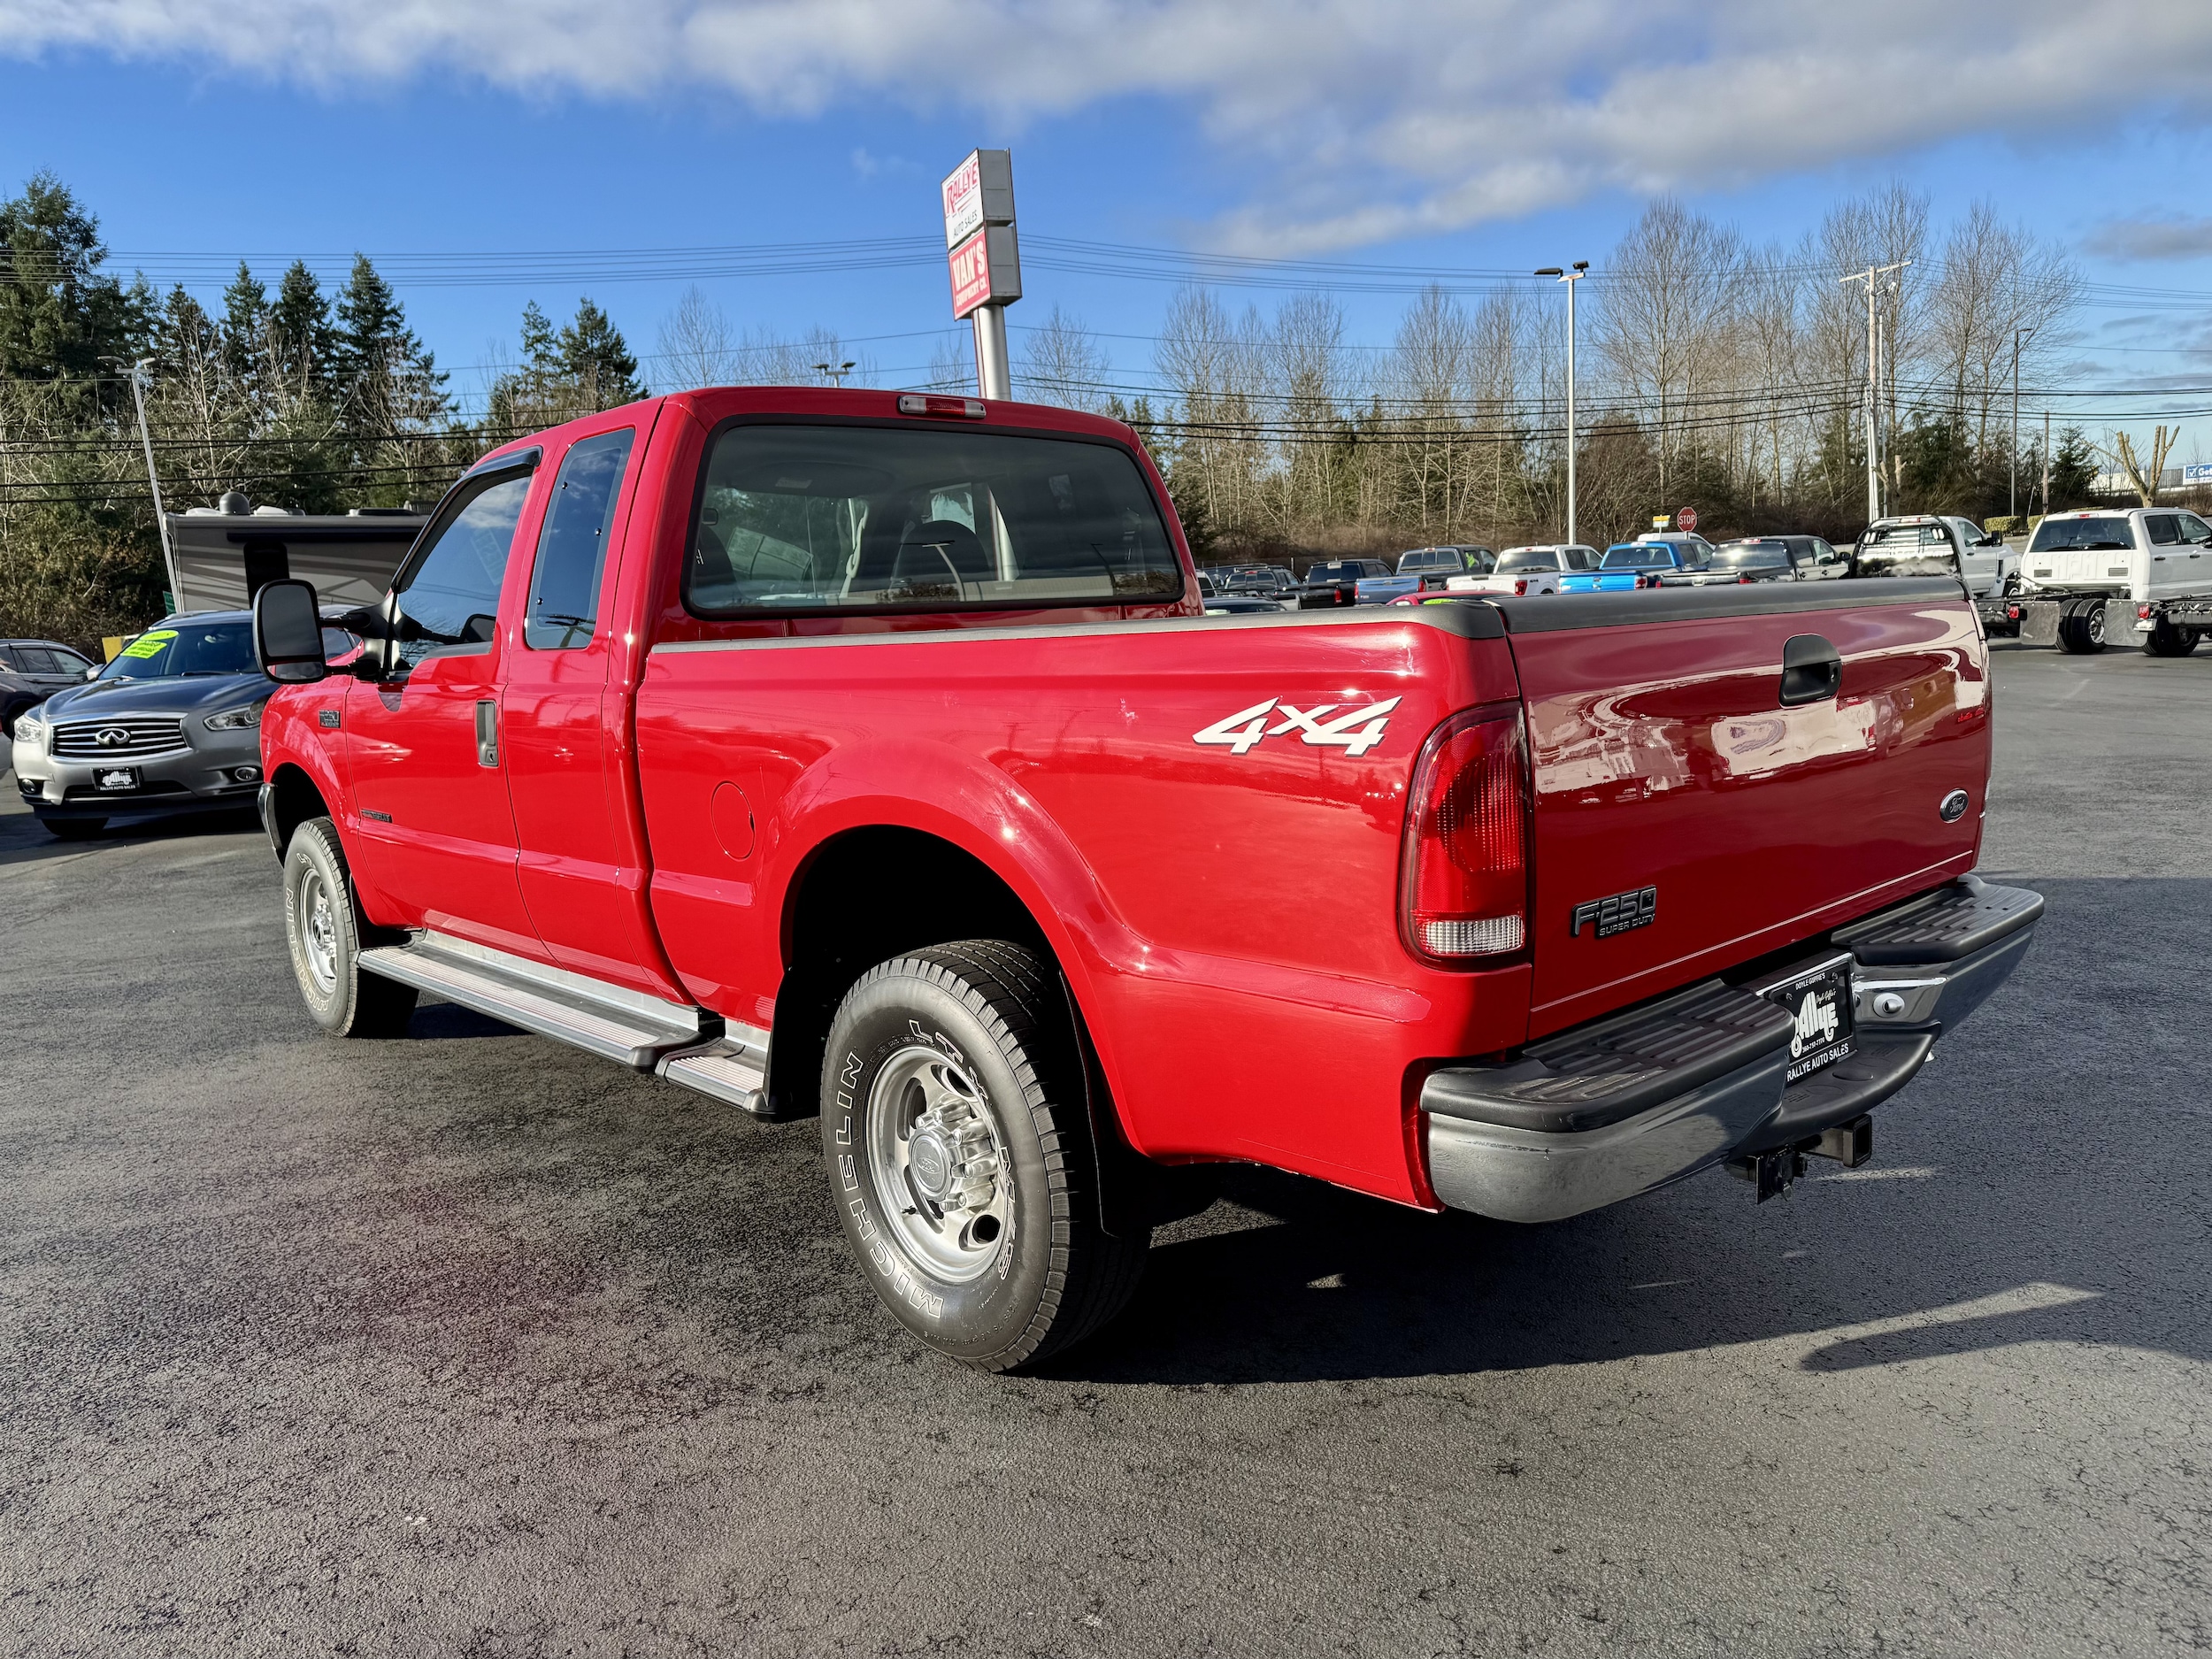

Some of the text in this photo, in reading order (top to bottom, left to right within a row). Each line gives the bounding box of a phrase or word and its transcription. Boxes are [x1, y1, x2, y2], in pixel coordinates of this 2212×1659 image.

[947, 161, 978, 214] RALLYE
[953, 209, 978, 239] AUTO SALES
[951, 240, 986, 292] VAN'S
[1679, 514, 1695, 525] STOP
[1599, 913, 1655, 936] SUPER DUTY
[286, 887, 330, 1012] MICHELIN
[1795, 979, 1809, 990] DOYLE
[1786, 1042, 1849, 1082] RALLYE AUTO SALES
[835, 1050, 944, 1320] MICHELIN
